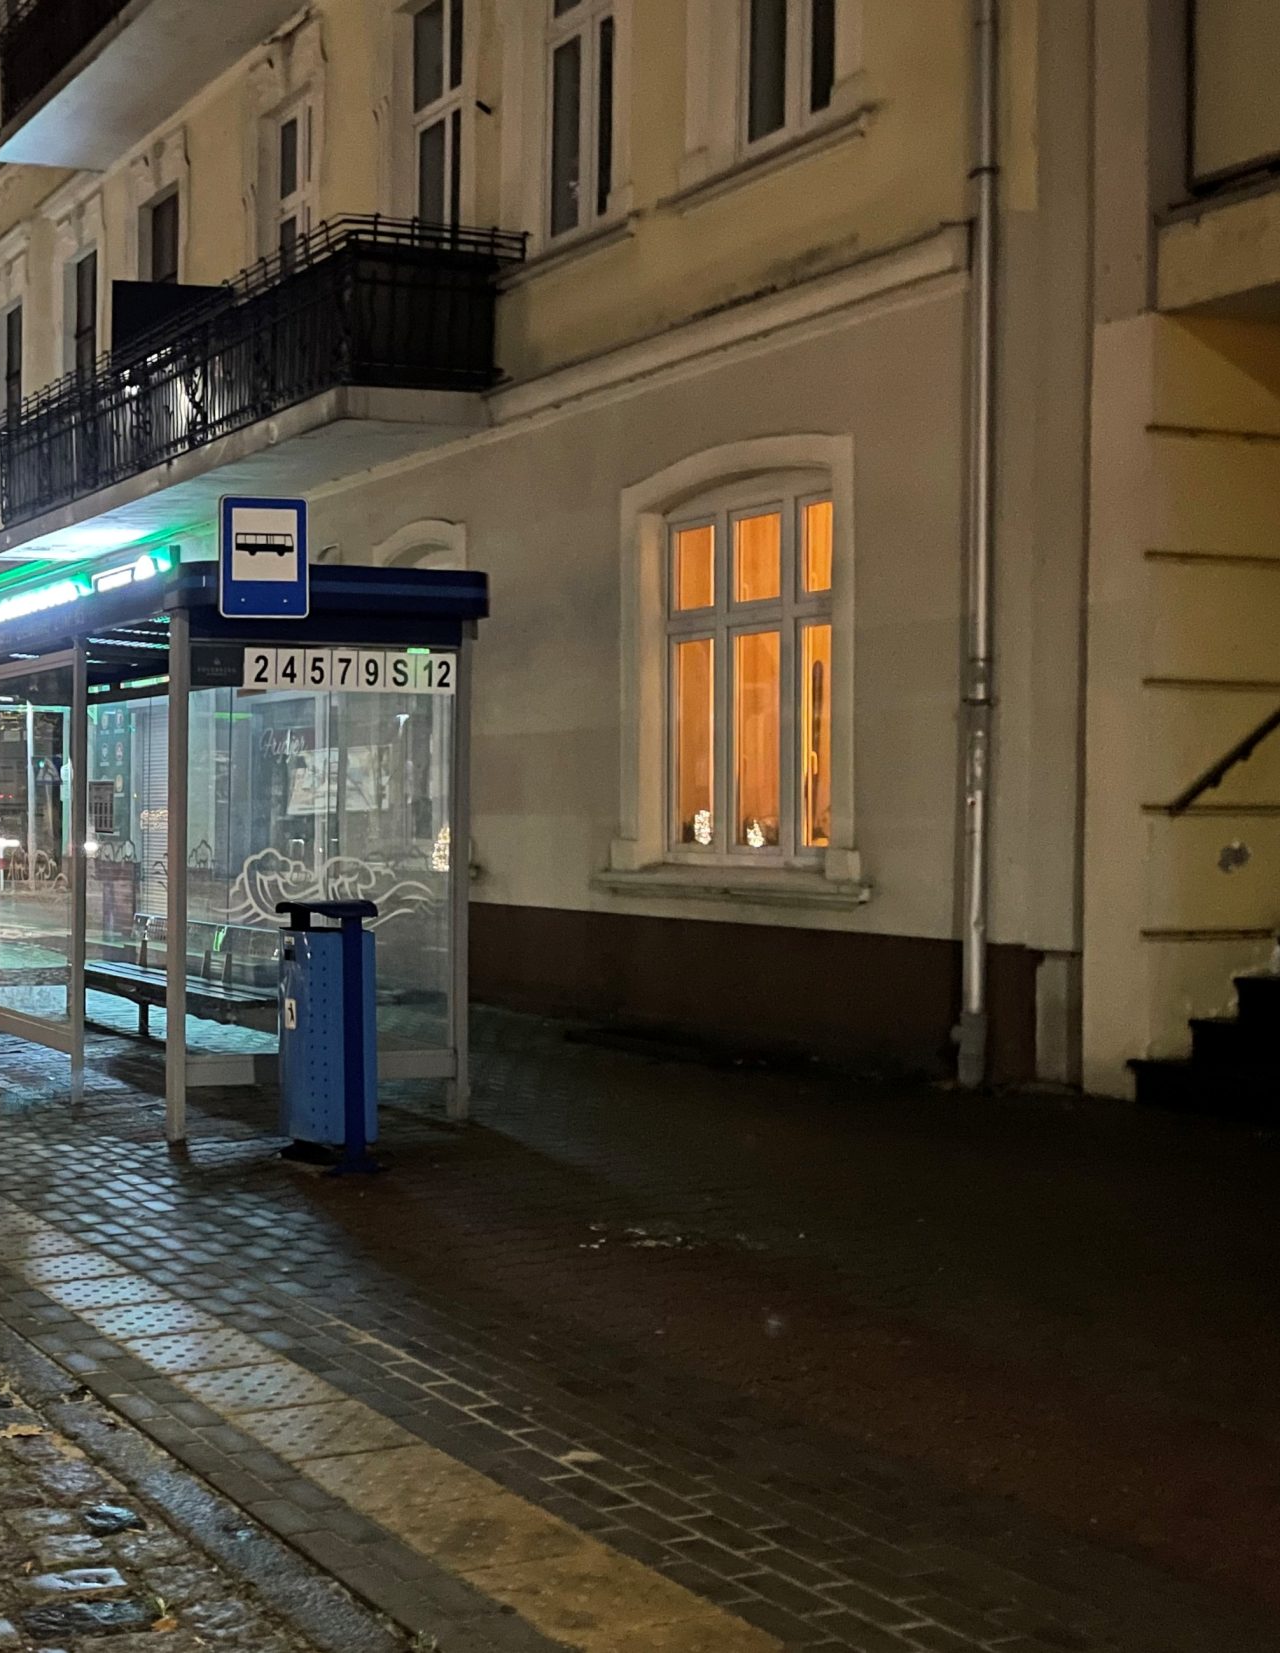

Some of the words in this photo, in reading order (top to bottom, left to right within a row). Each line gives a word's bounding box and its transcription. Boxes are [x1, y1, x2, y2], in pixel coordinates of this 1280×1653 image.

[253, 654, 269, 683] 2
[281, 655, 298, 684] 4
[310, 656, 325, 685] 5
[337, 657, 352, 686] 7
[364, 658, 379, 687] 9
[392, 659, 409, 687] S
[422, 660, 451, 688] 12
